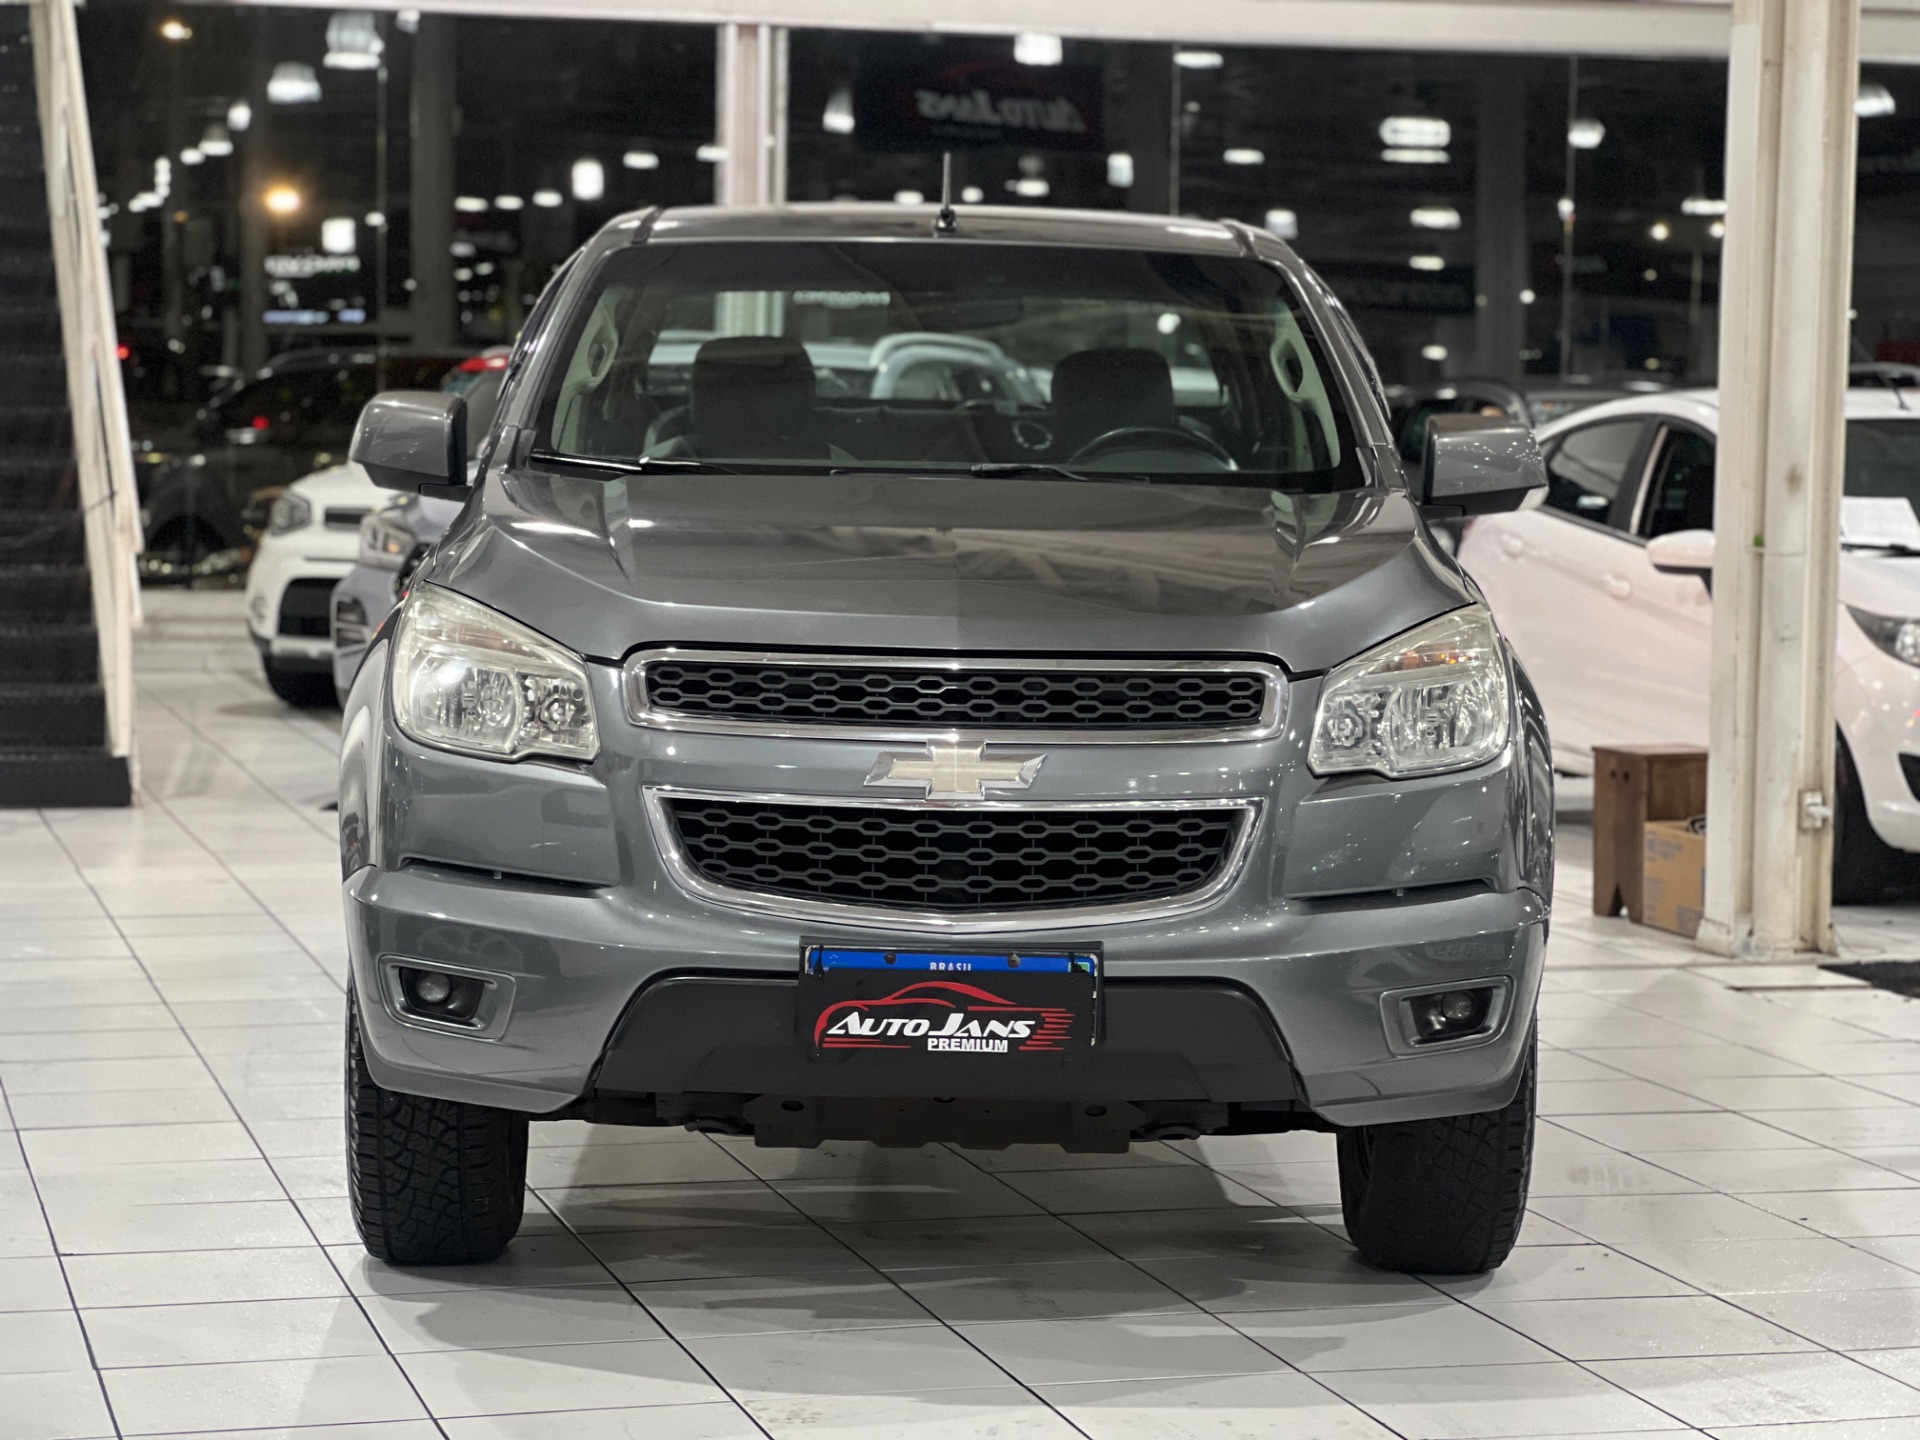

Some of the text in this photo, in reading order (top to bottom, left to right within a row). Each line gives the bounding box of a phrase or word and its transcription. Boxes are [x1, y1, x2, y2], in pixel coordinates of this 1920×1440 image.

[827, 1011, 1036, 1038] AUTO JANS
[927, 1037, 1008, 1053] PREMIUM
